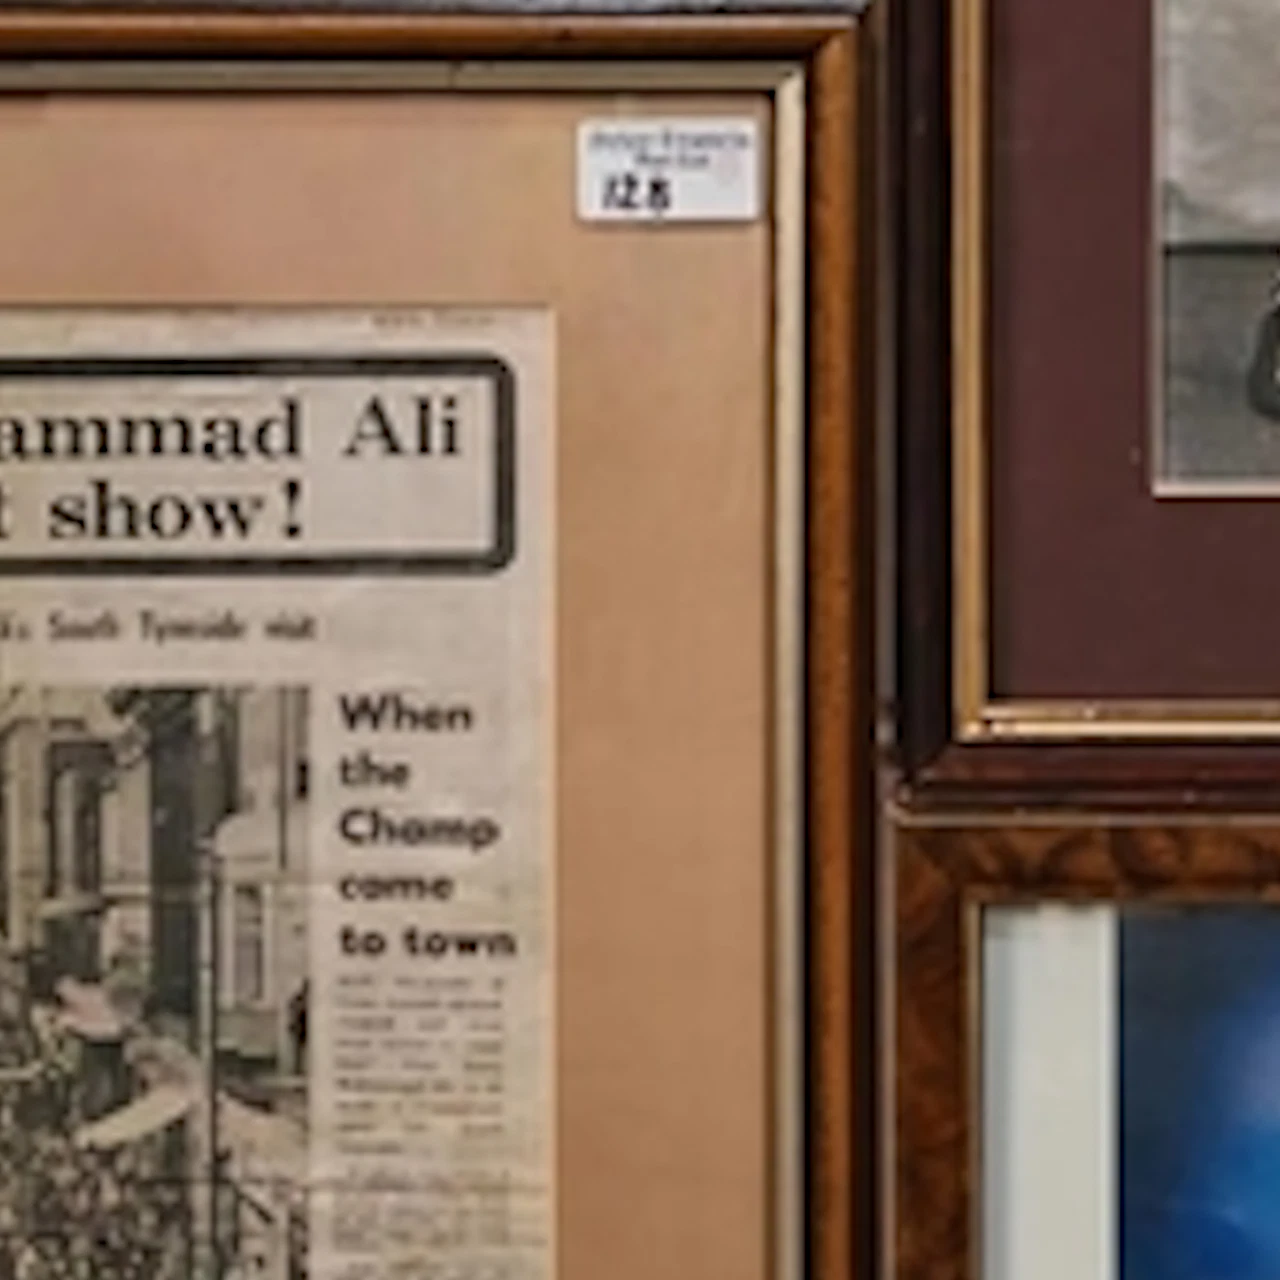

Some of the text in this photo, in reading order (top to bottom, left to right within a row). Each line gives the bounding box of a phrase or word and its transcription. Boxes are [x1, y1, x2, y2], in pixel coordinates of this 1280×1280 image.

[345, 395, 458, 457] Ali
[48, 478, 303, 540] show!
[338, 692, 475, 733] When
[337, 749, 412, 790] the
[337, 805, 503, 853] Champ
[337, 873, 456, 904] came
[338, 925, 519, 959] to town
